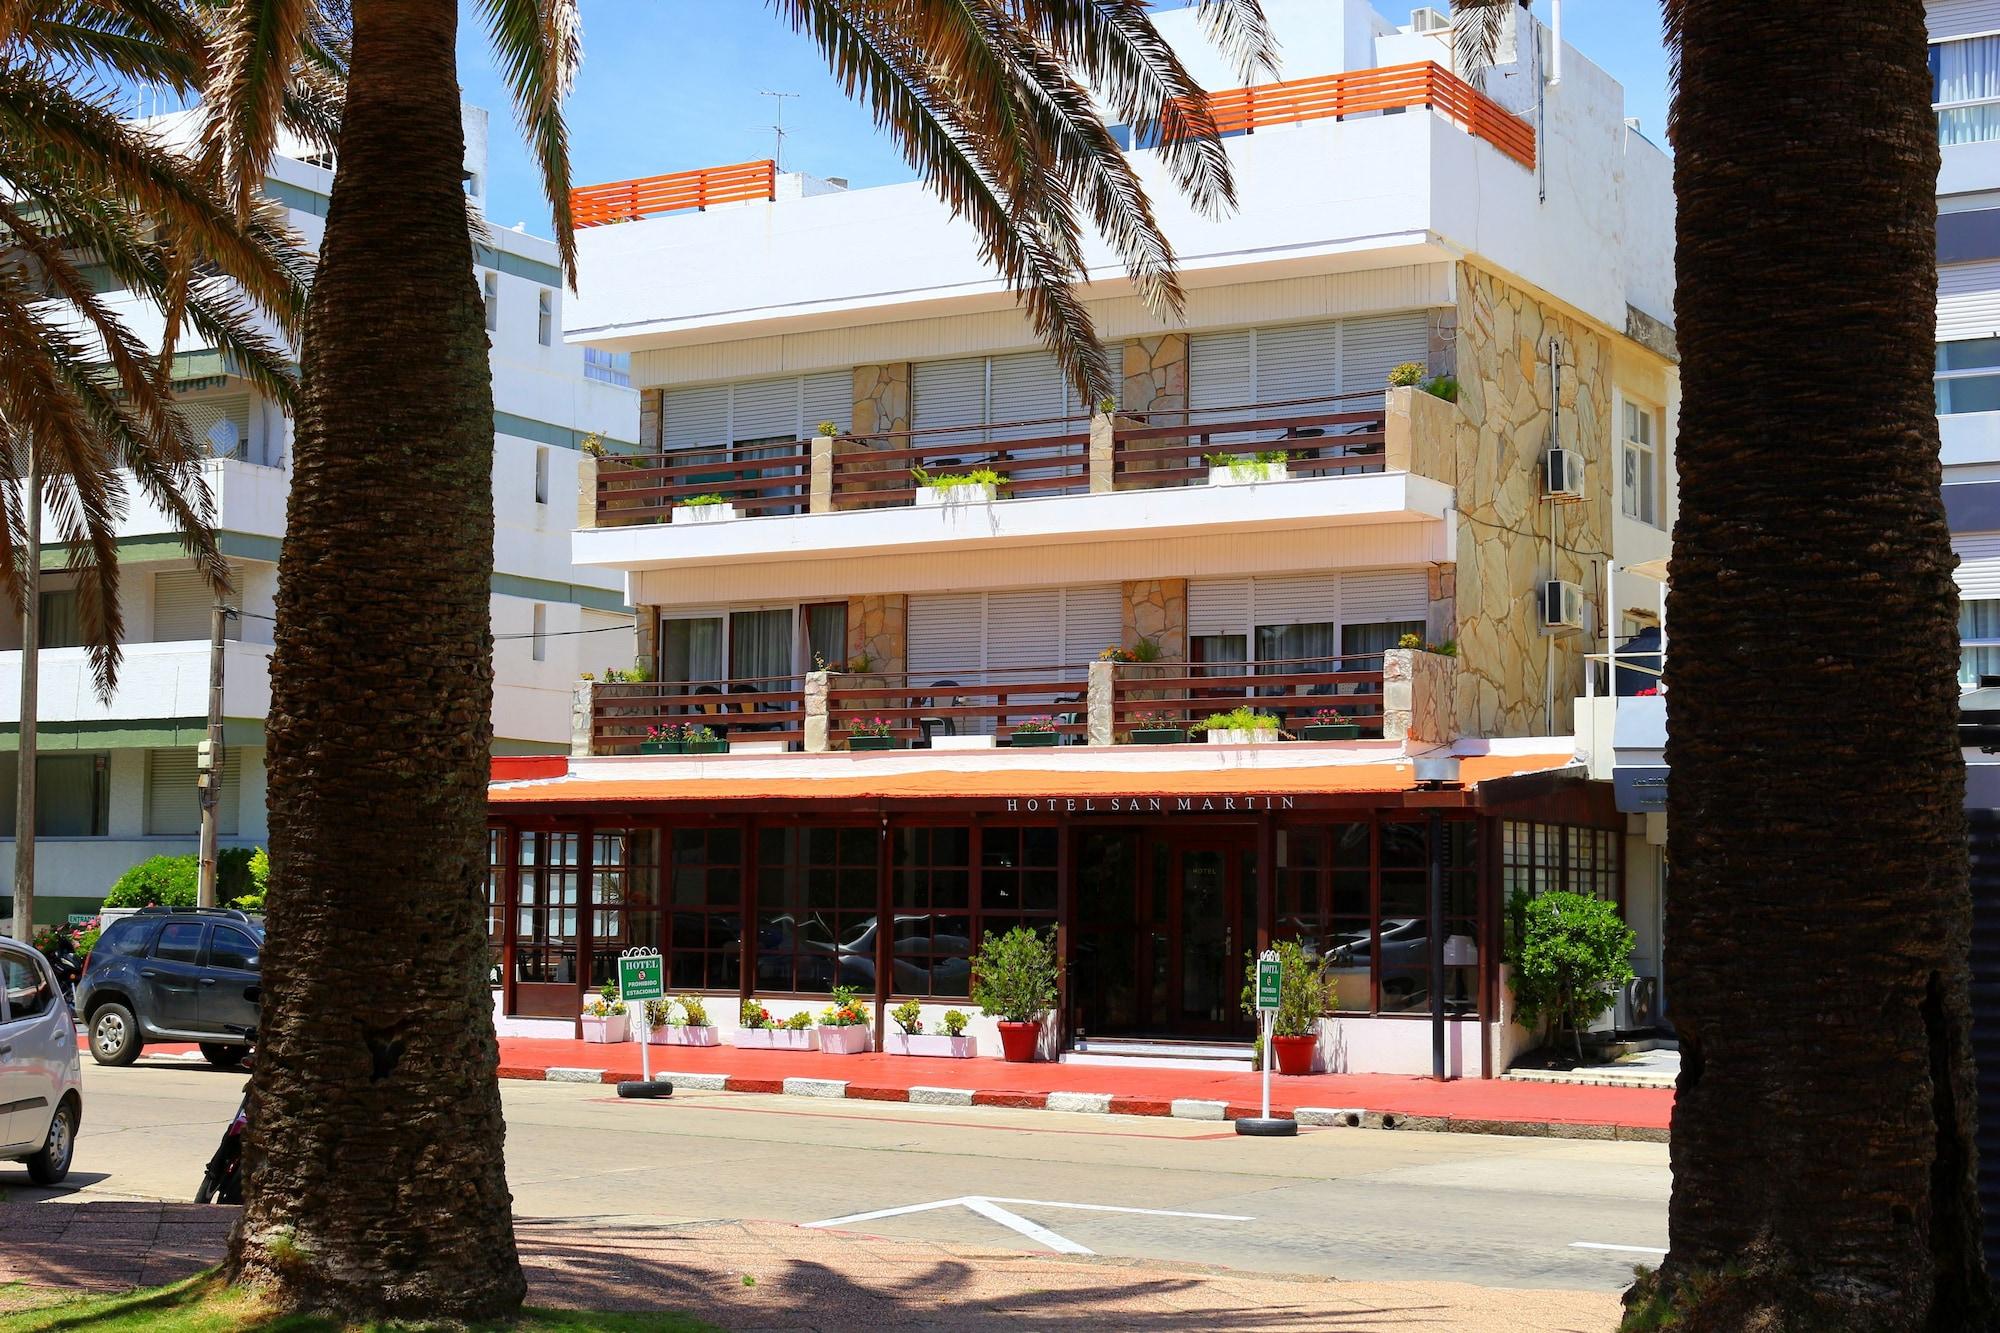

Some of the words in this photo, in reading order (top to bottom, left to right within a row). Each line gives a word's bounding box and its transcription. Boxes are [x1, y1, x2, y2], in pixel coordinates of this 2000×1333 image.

[1007, 799, 1095, 811] HOTEL
[1111, 797, 1161, 810] SAN
[1177, 795, 1294, 810] MARTIN
[626, 960, 658, 970] HOTEL
[1261, 964, 1279, 974] HOTEL
[626, 988, 660, 996] ESTACIONAR
